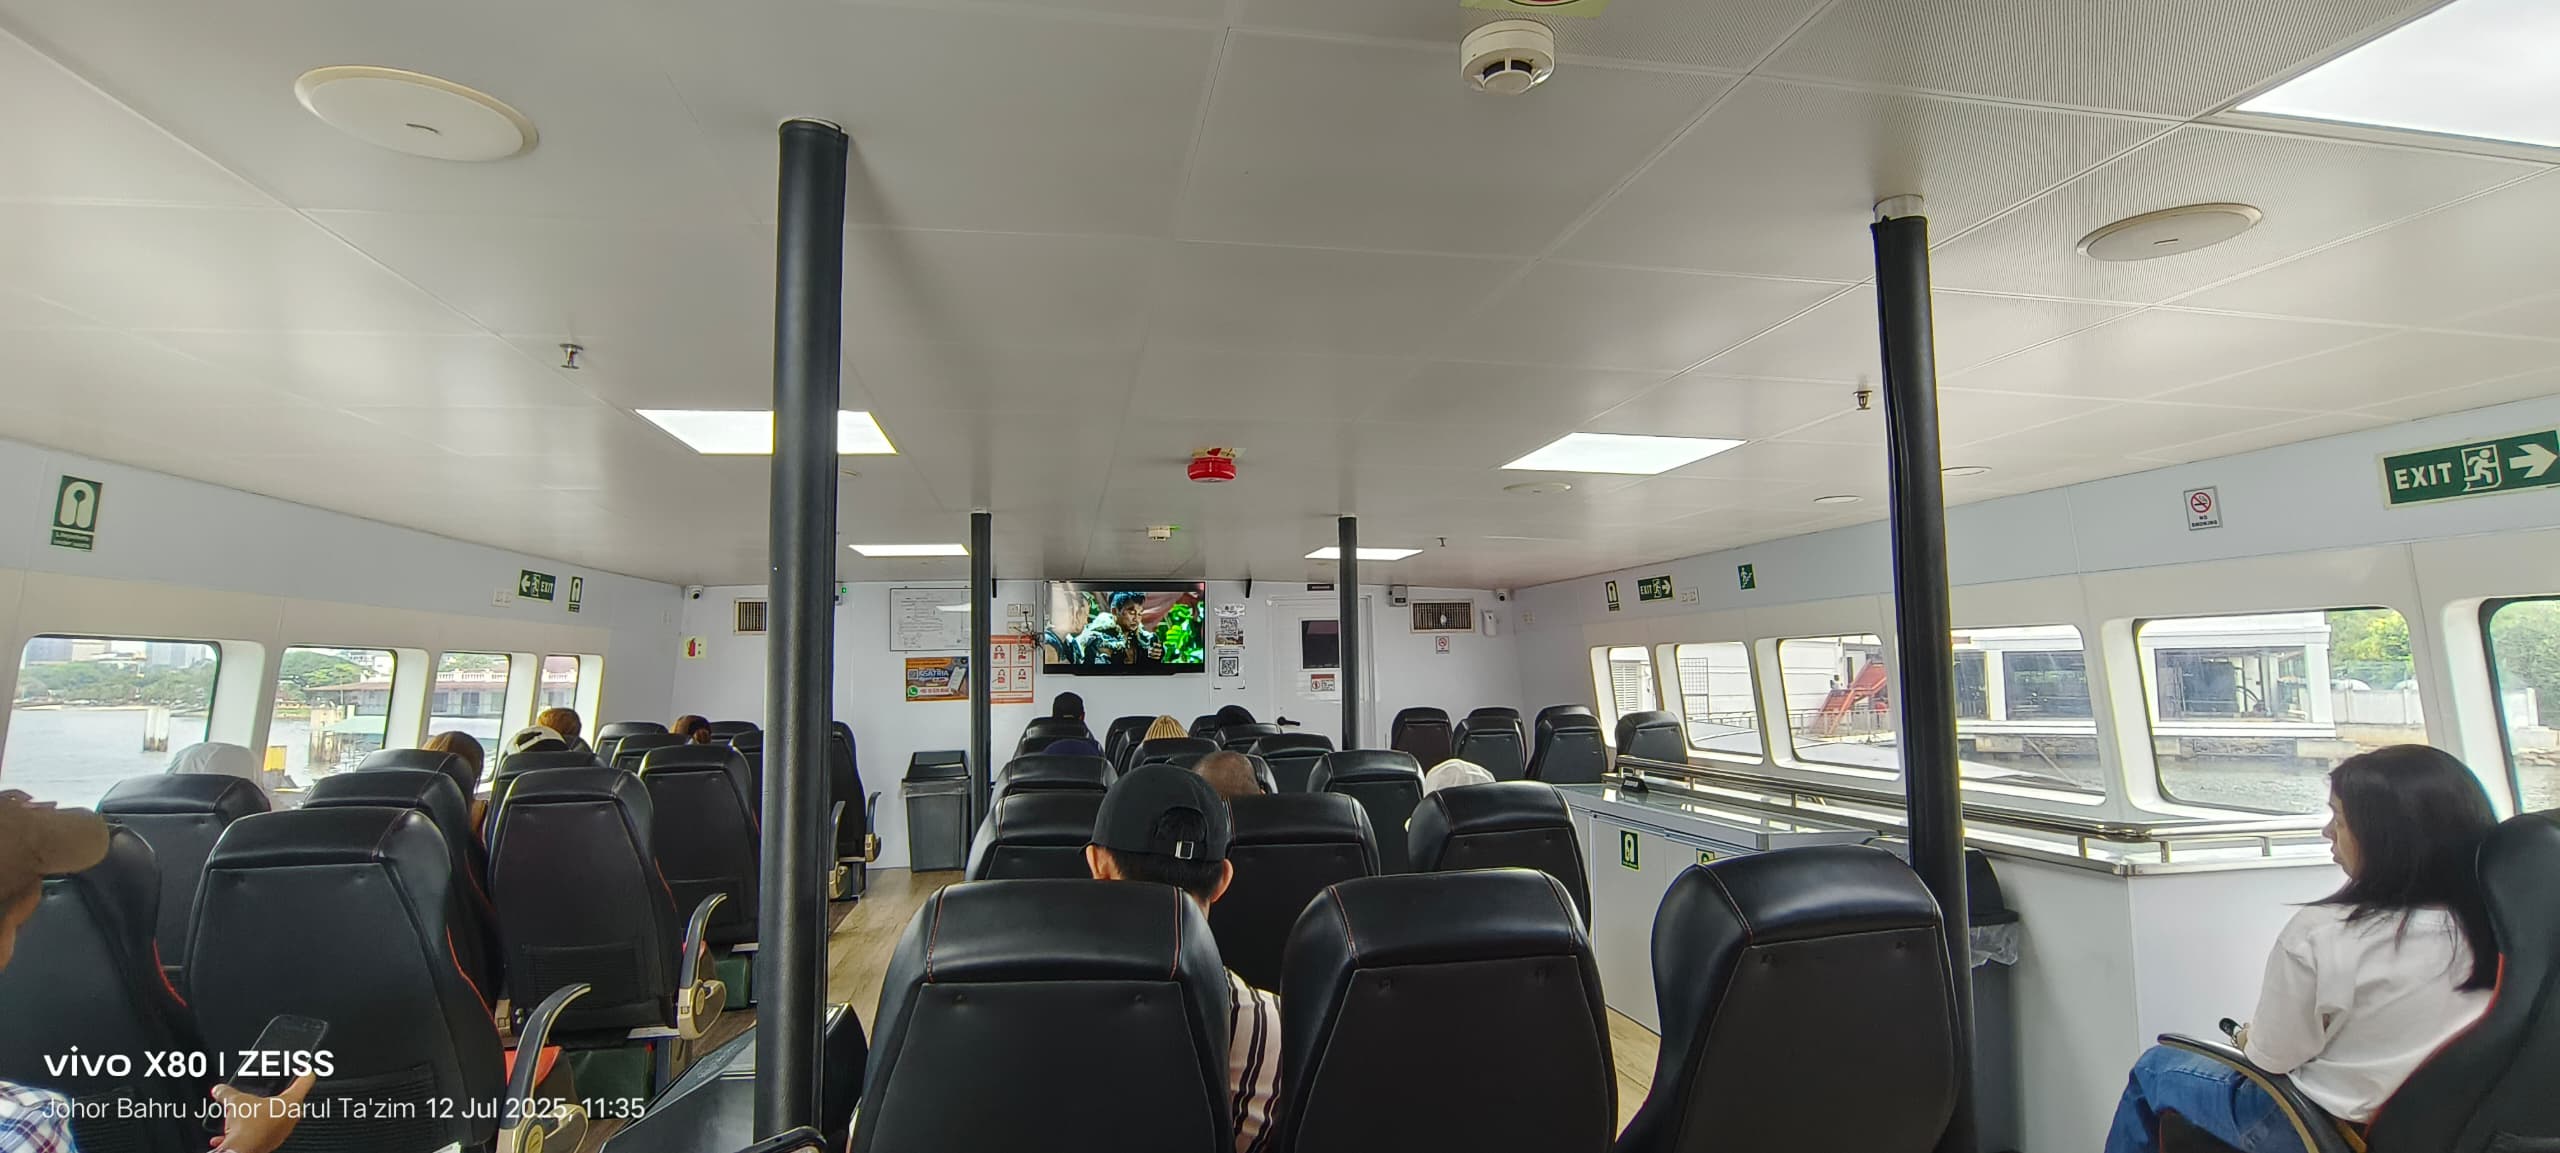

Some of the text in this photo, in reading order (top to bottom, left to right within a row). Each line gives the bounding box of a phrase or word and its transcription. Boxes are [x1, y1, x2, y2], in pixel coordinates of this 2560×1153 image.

[2394, 461, 2453, 490] EXIT
[541, 581, 553, 593] EXIT
[1640, 585, 1652, 595] EXIT
